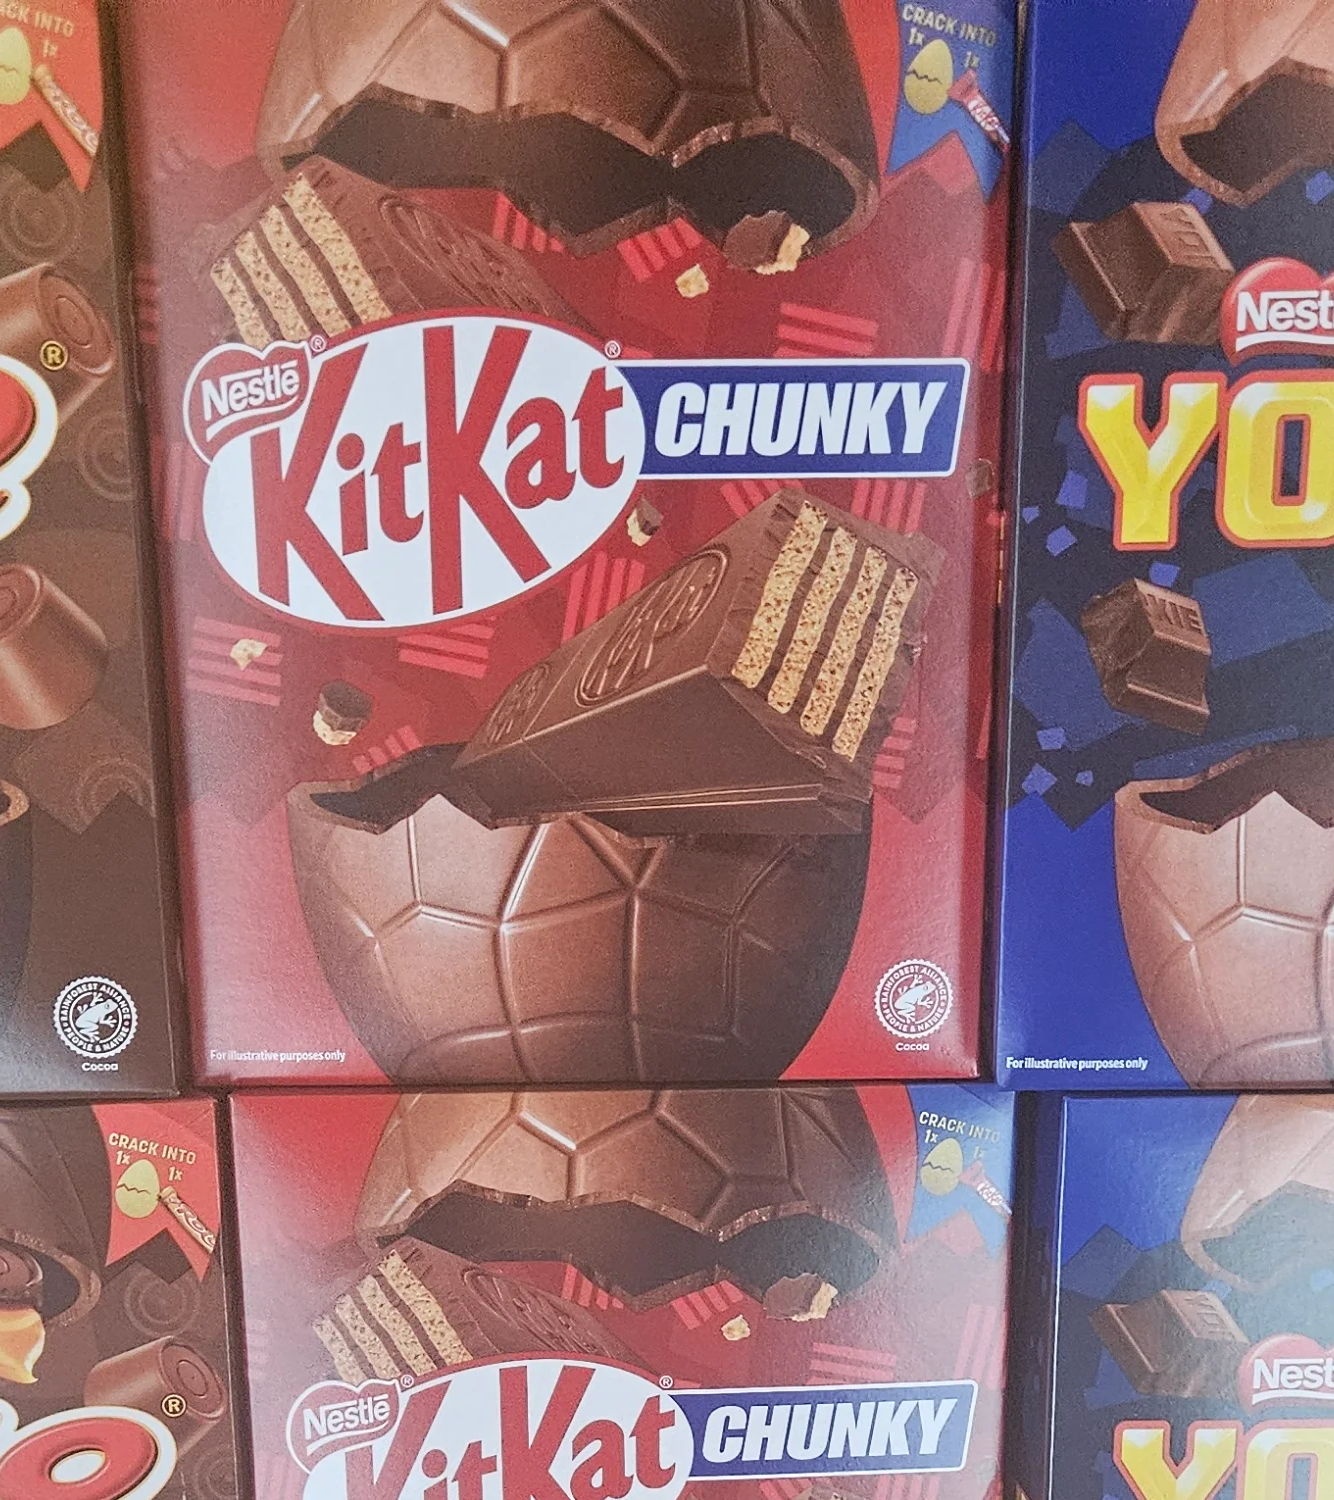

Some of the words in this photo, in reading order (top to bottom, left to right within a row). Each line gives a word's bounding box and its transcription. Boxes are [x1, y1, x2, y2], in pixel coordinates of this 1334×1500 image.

[34, 11, 74, 38] INTO
[902, 3, 958, 35] CRACK
[960, 23, 997, 47] INTO
[250, 325, 625, 621] KitKat
[655, 381, 947, 457] CHUNKY
[880, 964, 920, 1001] RAINFOREST
[921, 964, 948, 1002] ALLIANCE
[60, 982, 98, 1021] RAINFOREST
[99, 983, 131, 1021] ALLIANCE
[883, 1006, 908, 1033] PEOPLE
[918, 1006, 947, 1033] NATURE
[65, 1026, 96, 1053] PEOPLE
[101, 1024, 130, 1053] NATURE
[895, 1042, 930, 1052] Cocoa
[81, 1061, 119, 1072] Cocoa
[210, 1050, 226, 1061] For
[227, 1050, 278, 1061] illustrative
[279, 1052, 324, 1063] purposes
[324, 1050, 346, 1062] only
[1005, 1056, 1024, 1069] For
[1024, 1056, 1077, 1069] illustrative
[1078, 1059, 1124, 1071] purposes
[1126, 1057, 1148, 1071] only
[919, 1111, 965, 1134] CRACK
[968, 1125, 1001, 1143] INTO
[924, 1129, 939, 1144] 1x
[108, 1133, 158, 1156] CRACK
[161, 1145, 197, 1165] INTO
[116, 1151, 131, 1166] 1x
[168, 1167, 183, 1181] 1x
[704, 1400, 958, 1462] CHUNKY
